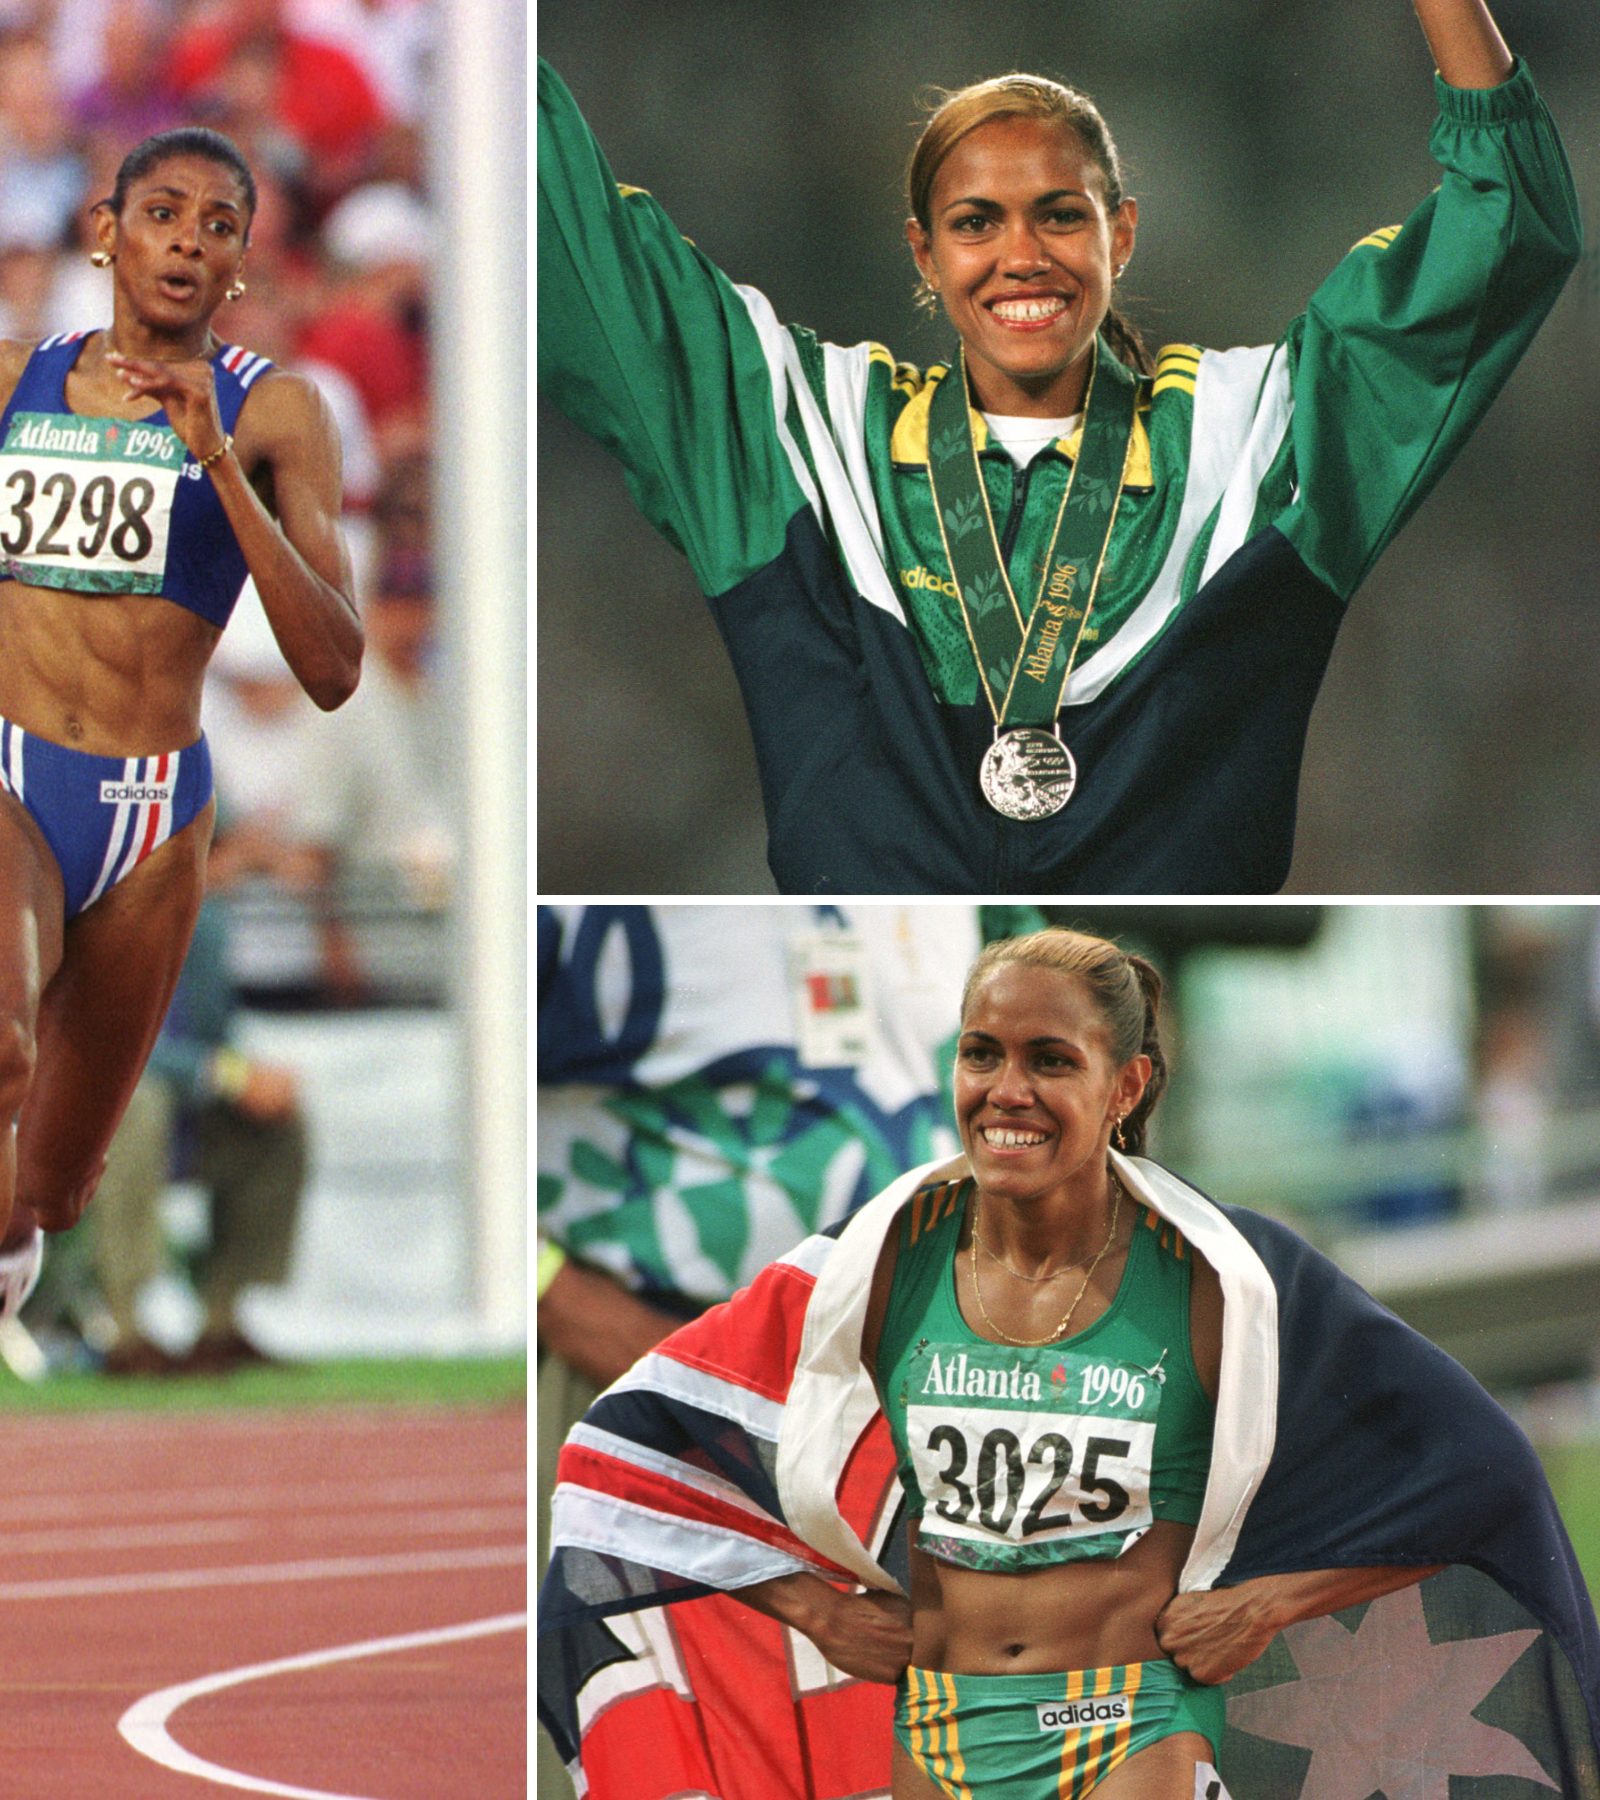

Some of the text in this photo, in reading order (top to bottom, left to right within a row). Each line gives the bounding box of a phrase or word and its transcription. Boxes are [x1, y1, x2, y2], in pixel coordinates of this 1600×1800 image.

[11, 420, 177, 462] Atlanta 1996
[0, 469, 155, 562] 3298
[1024, 563, 1077, 683] Atlanta 1996
[104, 785, 169, 800] adidas
[921, 1353, 1042, 1402] Atlanta
[1077, 1364, 1147, 1409] 1996
[926, 1424, 1131, 1537] 3025
[1042, 1702, 1126, 1727] adidas
